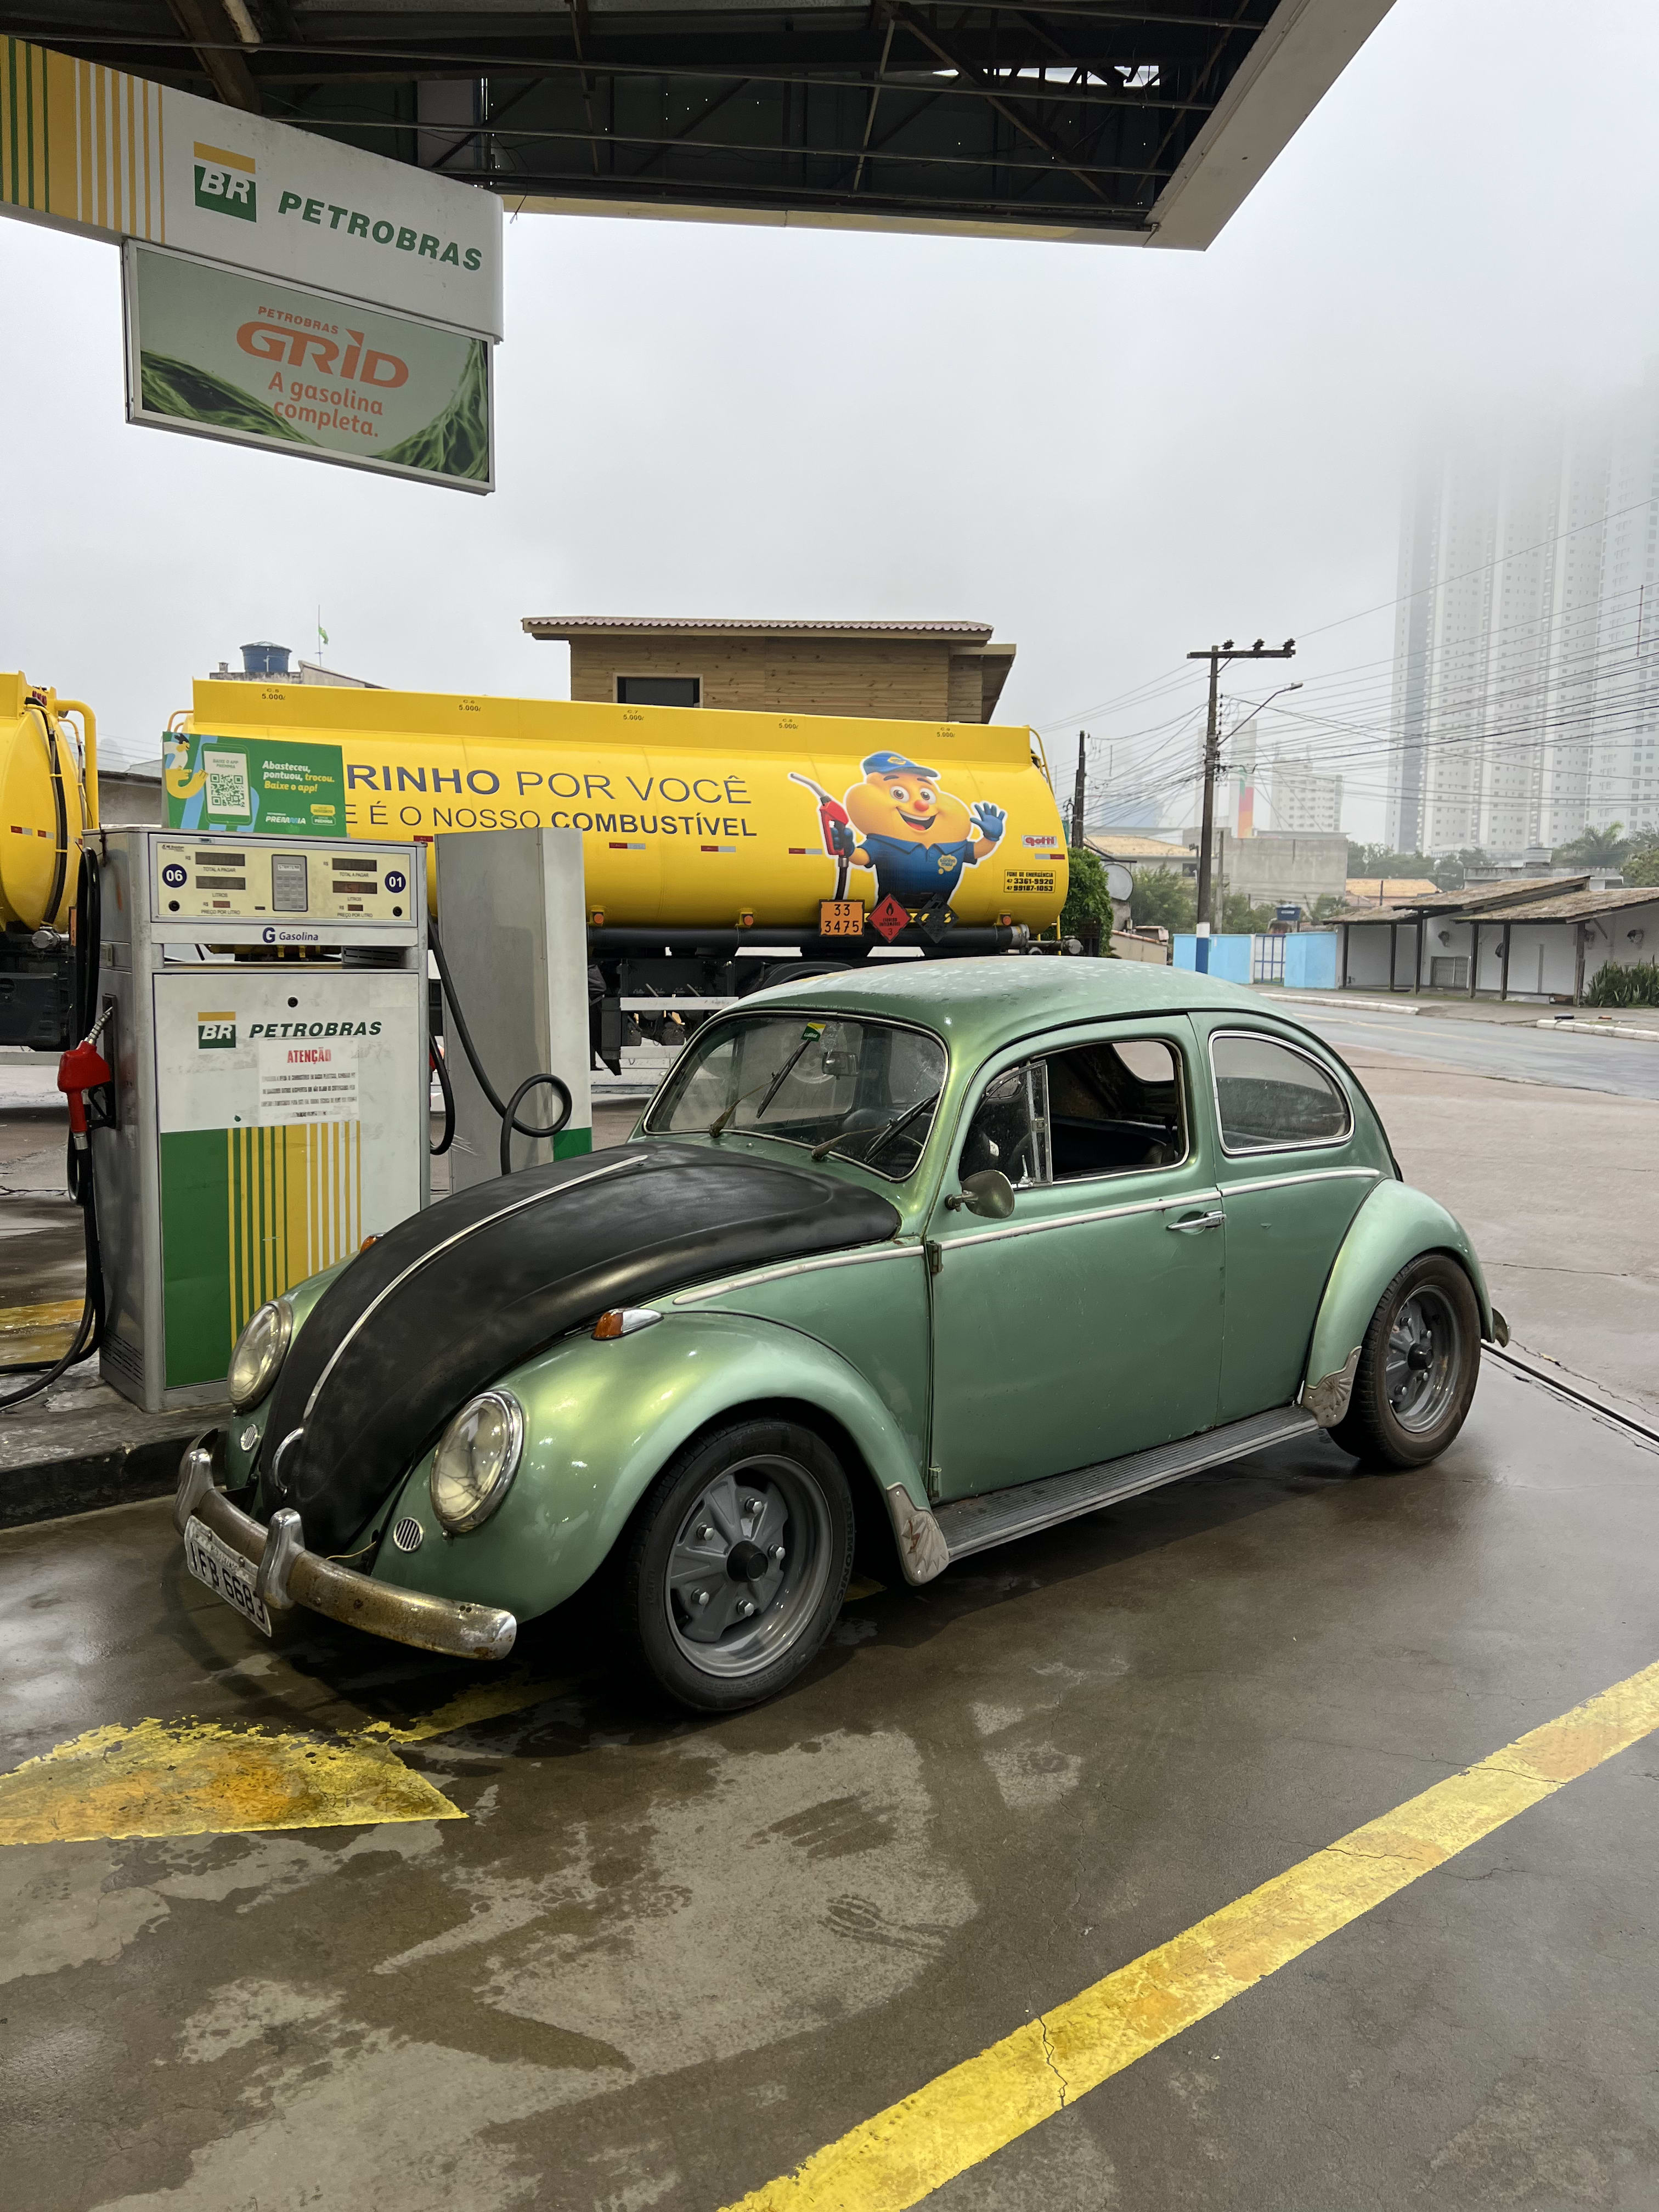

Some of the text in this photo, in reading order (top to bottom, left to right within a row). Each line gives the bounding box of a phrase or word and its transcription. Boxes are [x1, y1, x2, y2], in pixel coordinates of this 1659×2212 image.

[200, 171, 482, 271] BR PETROBRAS
[257, 306, 339, 335] PETROBRAS
[268, 371, 383, 416] A gasolina
[274, 401, 379, 437] completa.
[262, 760, 311, 773] Abasteceu,
[263, 771, 335, 783] pontuou, trocou.
[264, 780, 289, 790] Baixe
[298, 783, 318, 793] app!
[516, 771, 616, 799] POR
[625, 775, 752, 804] VOCÊ
[370, 800, 388, 825] É
[399, 806, 421, 826] O
[433, 807, 541, 829] NOSSO
[551, 811, 758, 837] COMBUSTÍVEL
[166, 870, 183, 882] 06
[388, 876, 403, 888] 01
[834, 904, 850, 916] 33
[262, 927, 318, 943] G Gasolina
[825, 920, 859, 933] 3475
[201, 1021, 382, 1040] BR PETROBRAS
[286, 1046, 332, 1064] ATENÇÃO
[190, 1542, 220, 1588] IFB
[222, 1567, 266, 1624] 6683
